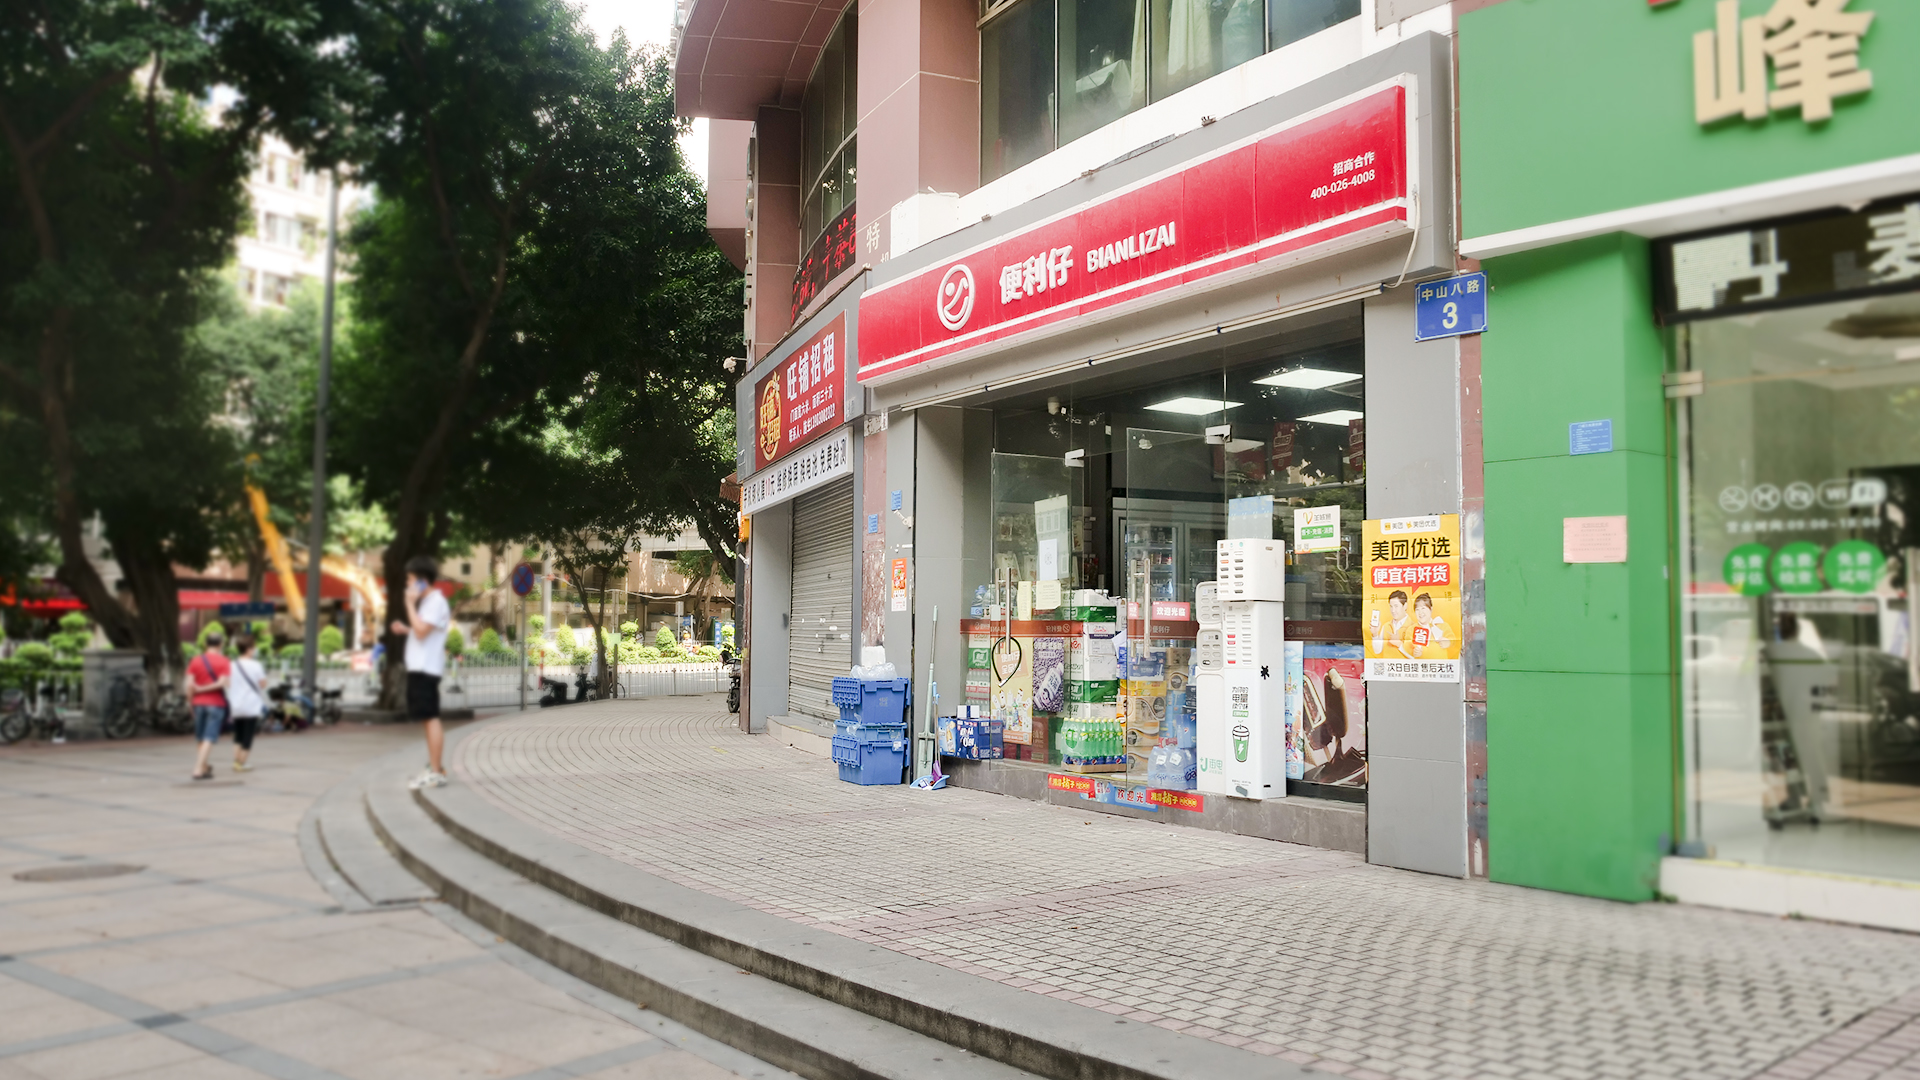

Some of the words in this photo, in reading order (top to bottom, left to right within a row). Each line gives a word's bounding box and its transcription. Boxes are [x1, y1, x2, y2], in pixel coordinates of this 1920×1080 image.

[1693, 0, 1876, 124] 峰
[1333, 151, 1376, 177] 招商合作
[1310, 169, 1376, 200] 400-026-4008
[866, 221, 880, 254] 特
[999, 245, 1073, 305] 便利仔
[1086, 221, 1176, 273] BIANLIZAI
[1421, 279, 1480, 302] 中山八路
[1442, 301, 1459, 329] 3
[787, 331, 836, 402] 旺铺招租
[1371, 536, 1451, 562] 美团优选
[1373, 565, 1448, 585] 便宜有好货
[1156, 606, 1186, 617] 欢迎光临
[1414, 628, 1428, 645] 省
[1387, 662, 1419, 673] 次日自提
[1421, 663, 1454, 673] 售后无忧
